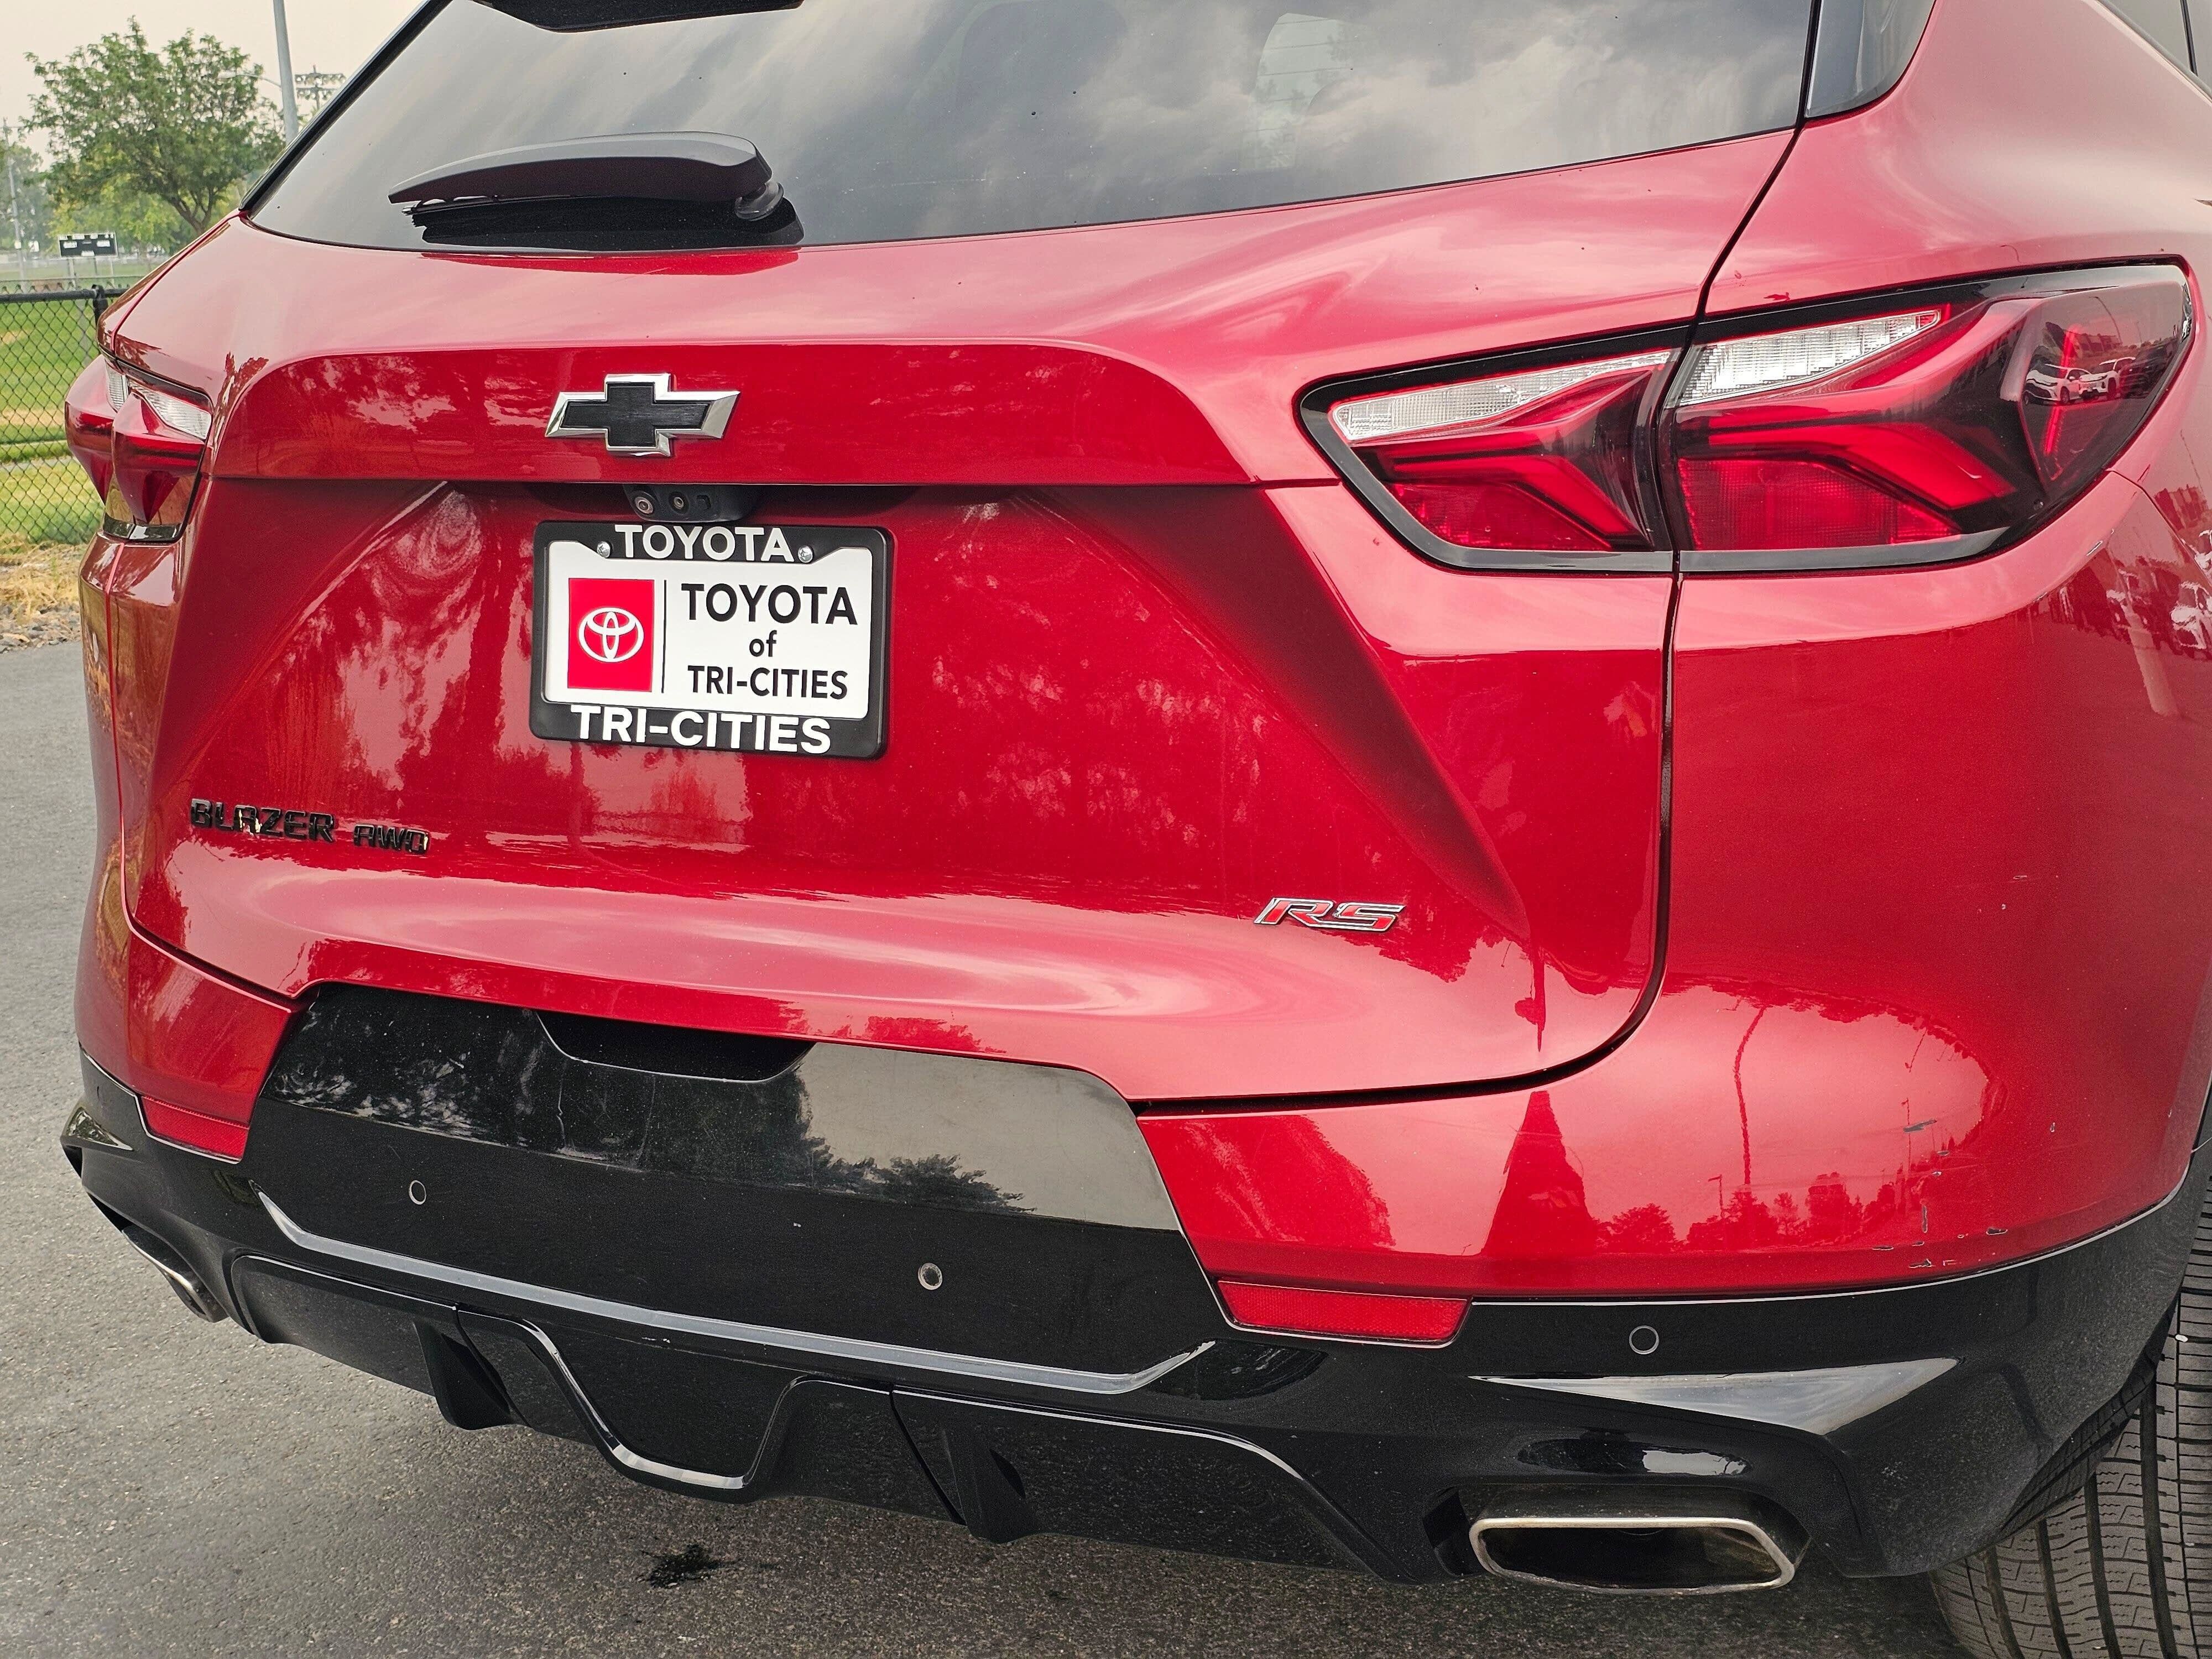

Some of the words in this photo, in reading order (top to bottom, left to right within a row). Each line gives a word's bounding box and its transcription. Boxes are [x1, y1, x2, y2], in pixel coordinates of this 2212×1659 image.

[615, 524, 795, 562] TOYOTA
[681, 583, 858, 625] TOYOTA
[749, 630, 777, 658] of
[687, 665, 848, 700] TRI-CITIES
[570, 705, 831, 754] TRI-CITIES
[190, 797, 333, 843] BLAZER
[353, 823, 430, 854] AWD
[1254, 897, 1407, 932] RS
